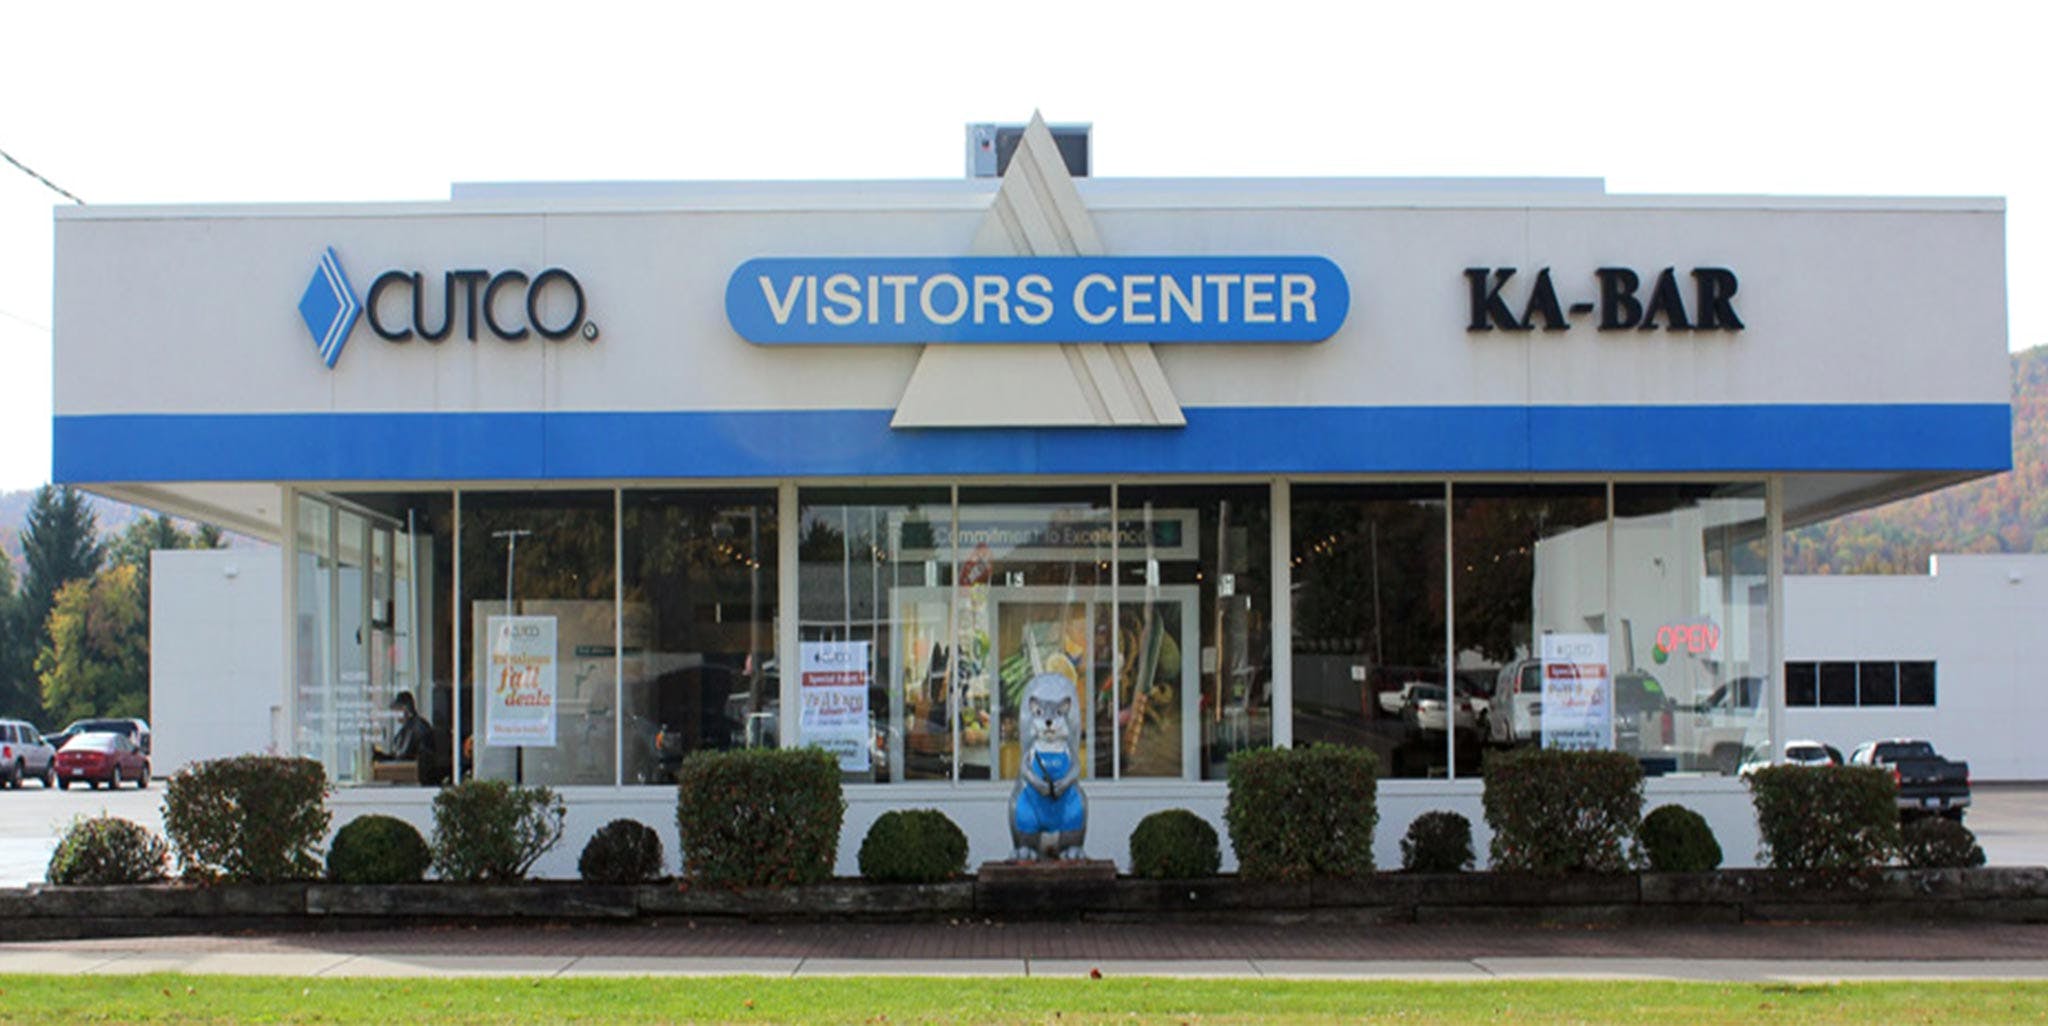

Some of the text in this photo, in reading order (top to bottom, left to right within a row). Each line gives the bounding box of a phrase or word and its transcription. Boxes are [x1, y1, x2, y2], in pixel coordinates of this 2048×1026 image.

[366, 268, 585, 343] CUTCO
[759, 273, 1318, 326] VISITORS CENTER
[1463, 266, 1745, 332] KA-BAR
[1655, 623, 1720, 654] OPEN
[496, 664, 540, 694] fall
[505, 688, 551, 706] deals
